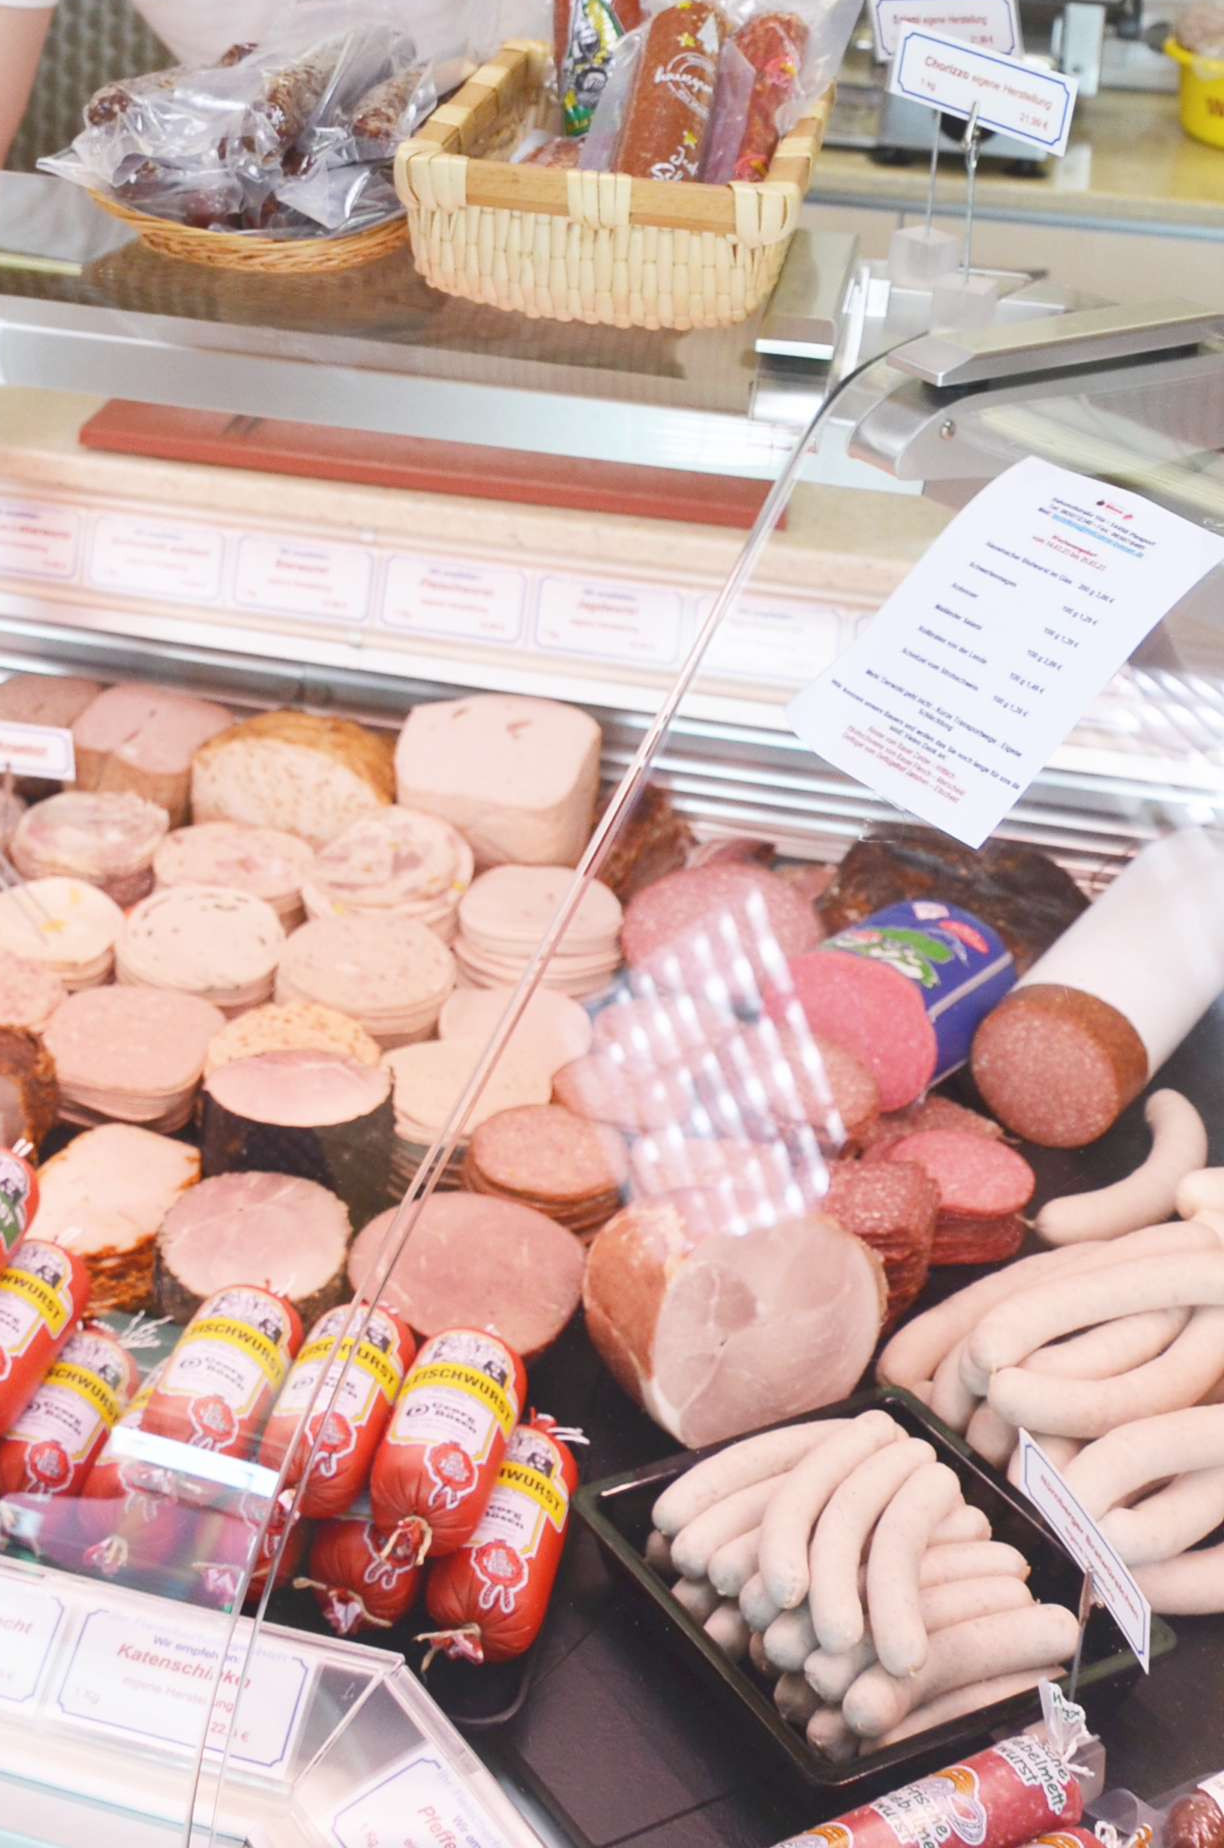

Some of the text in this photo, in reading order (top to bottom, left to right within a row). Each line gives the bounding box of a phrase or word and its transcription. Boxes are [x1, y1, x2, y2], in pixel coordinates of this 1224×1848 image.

[925, 56, 1053, 111] Chorizzo eigene Herstellung
[153, 1635, 240, 1664] Wir empfehen:
[84, 1688, 100, 1705] Kg
[123, 1676, 235, 1712] eigene Herstelung
[241, 1729, 250, 1743] €
[453, 1815, 469, 1833] Wir
